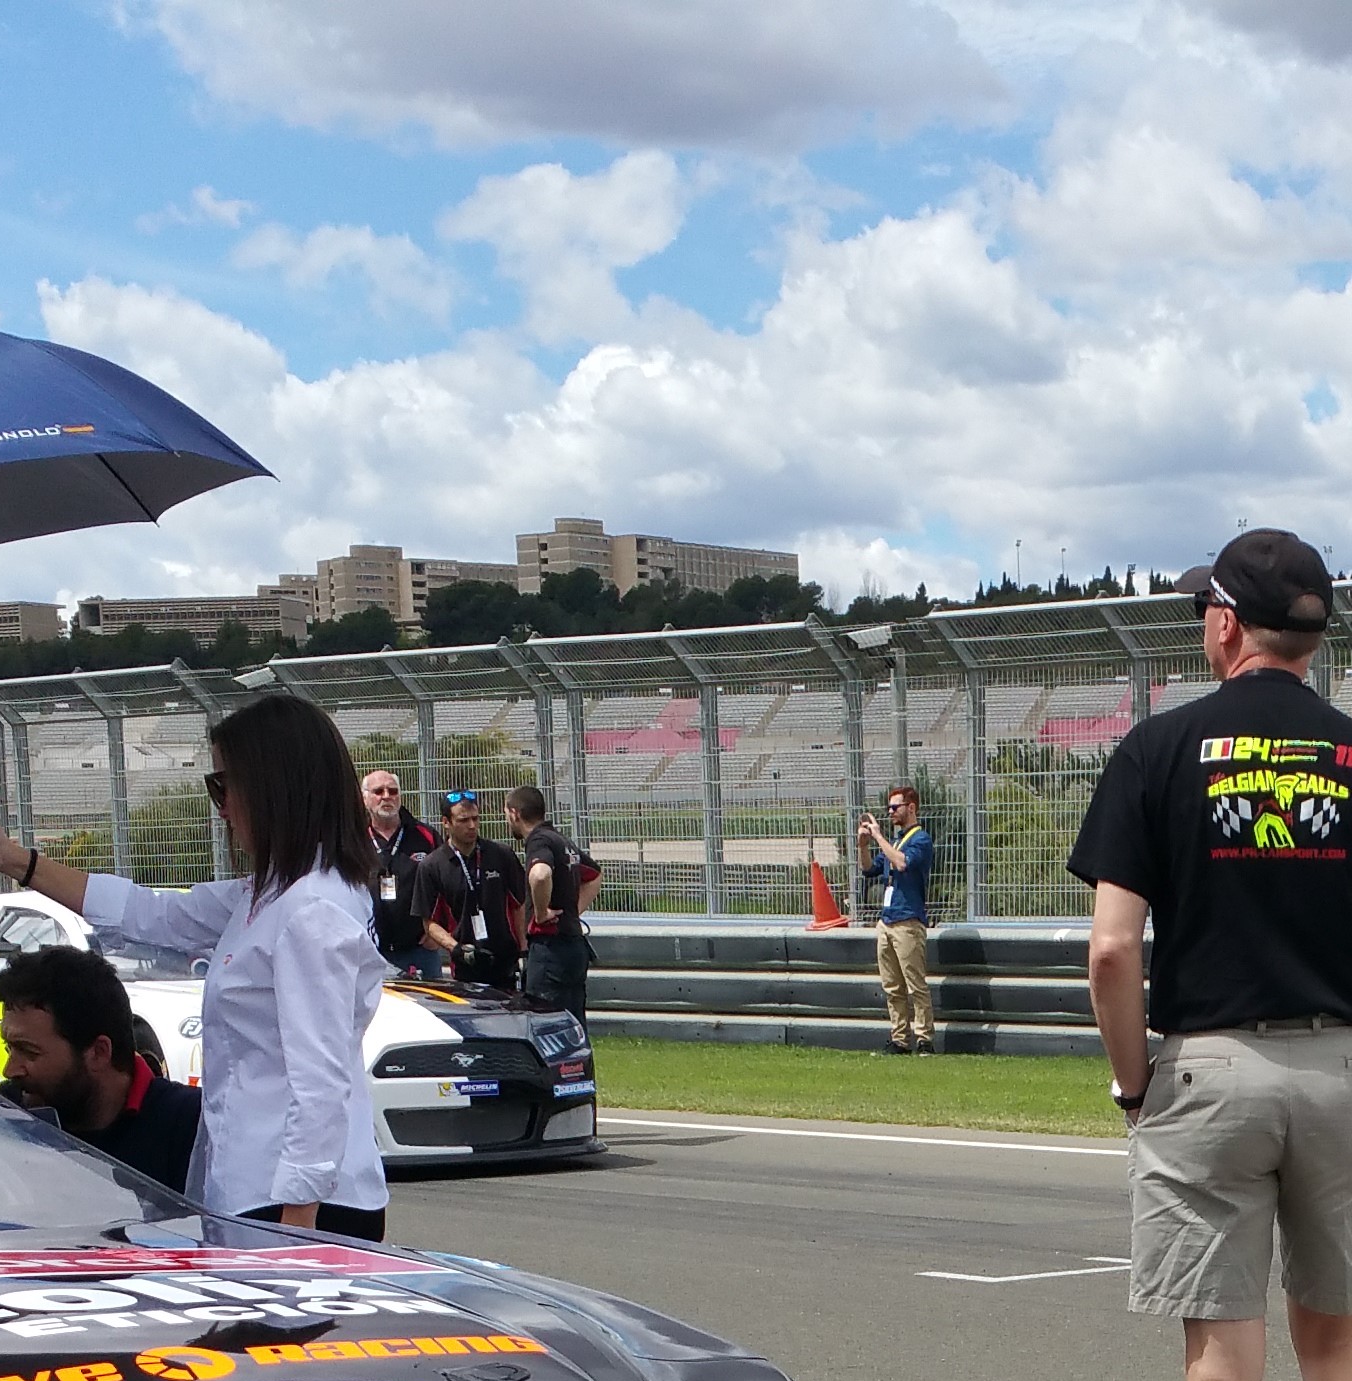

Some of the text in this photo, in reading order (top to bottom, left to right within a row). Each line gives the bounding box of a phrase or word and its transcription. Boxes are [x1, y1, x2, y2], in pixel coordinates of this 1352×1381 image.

[1233, 737, 1271, 762] 24
[1208, 769, 1349, 799] BELGIAN GAULS
